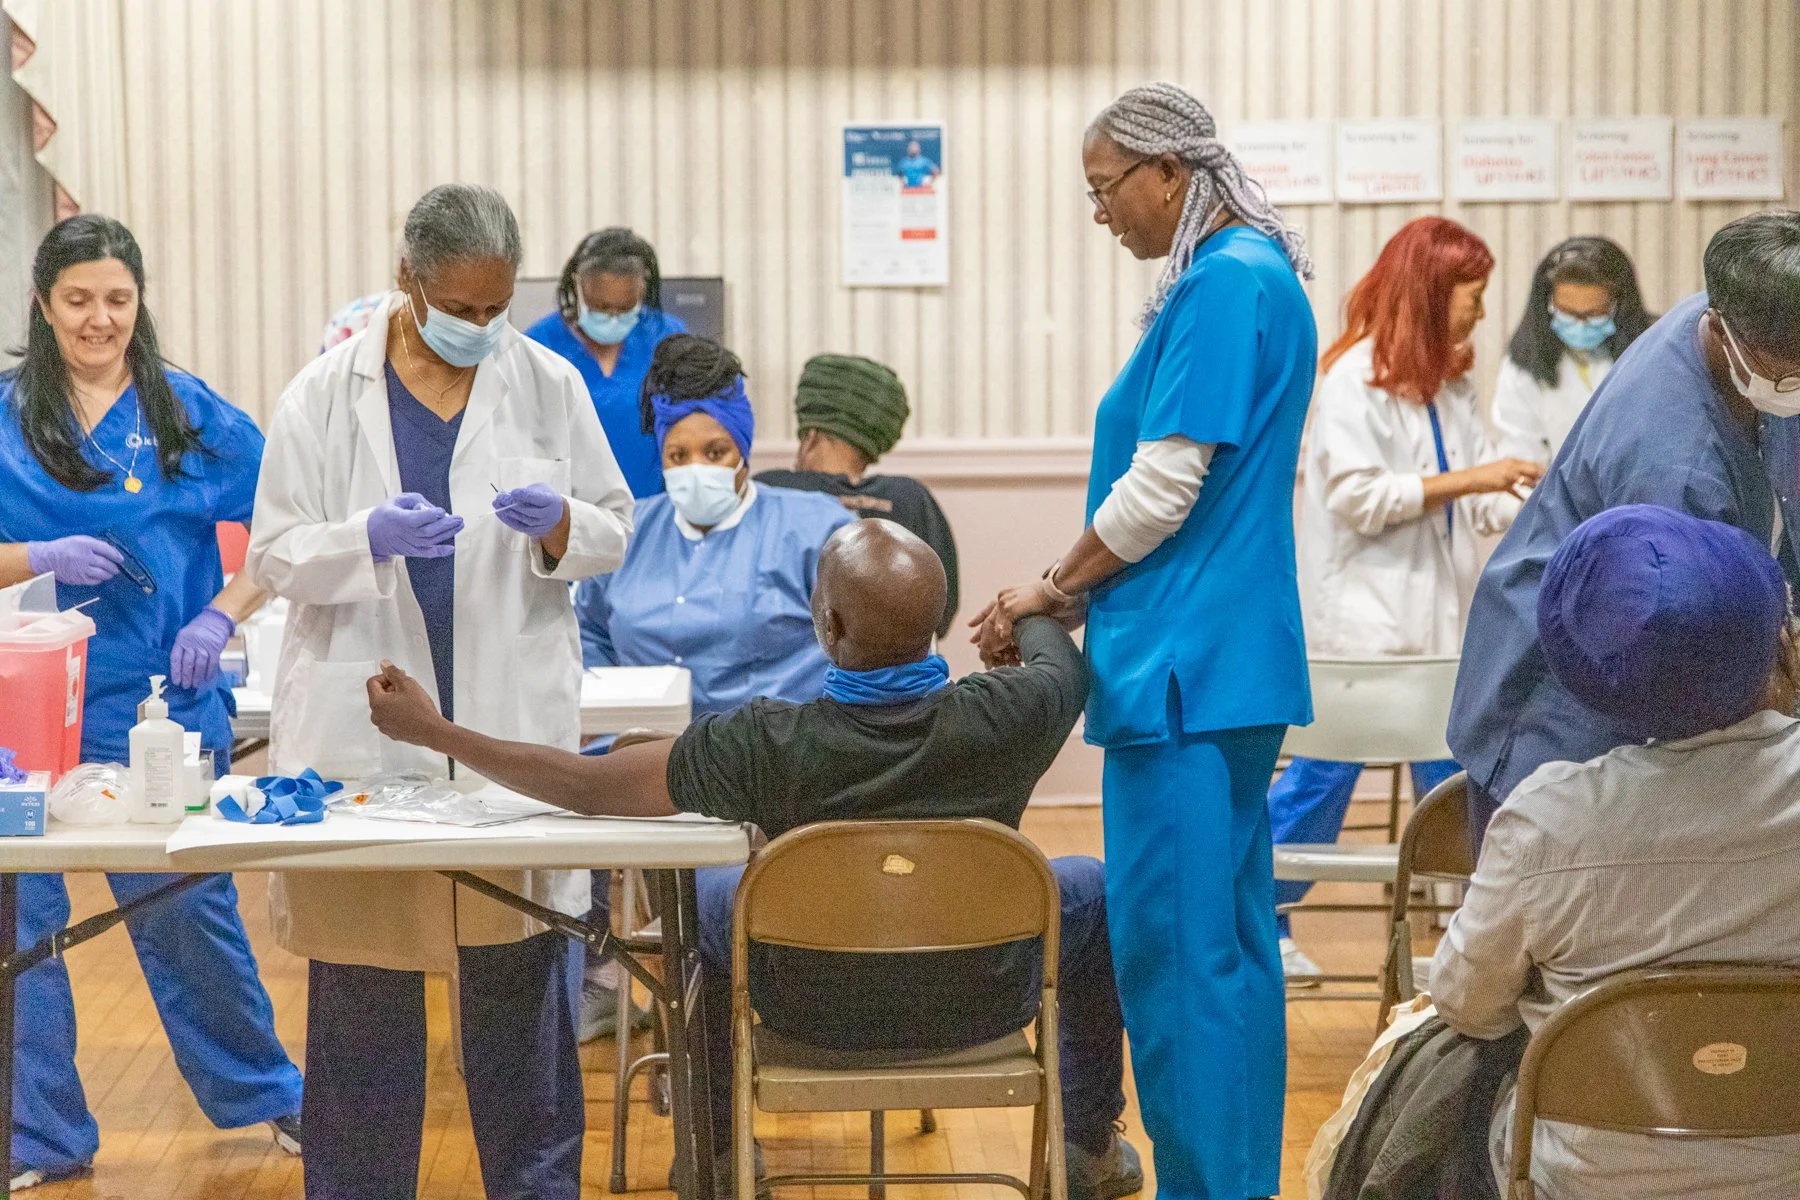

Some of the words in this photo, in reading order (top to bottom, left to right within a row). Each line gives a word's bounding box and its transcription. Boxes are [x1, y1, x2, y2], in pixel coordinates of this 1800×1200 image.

[1345, 131, 1397, 144] Screening
[1401, 131, 1417, 142] for
[1463, 135, 1515, 148] Screening
[1518, 134, 1534, 145] for
[1576, 131, 1629, 143] Screening
[1687, 131, 1740, 143] Screening
[1236, 142, 1287, 153] Screening
[1463, 156, 1524, 168] Diabetes
[1576, 150, 1611, 162] Colon
[1613, 150, 1655, 162] Cancer
[1687, 151, 1718, 164] Lung
[1722, 151, 1769, 163] Cancer
